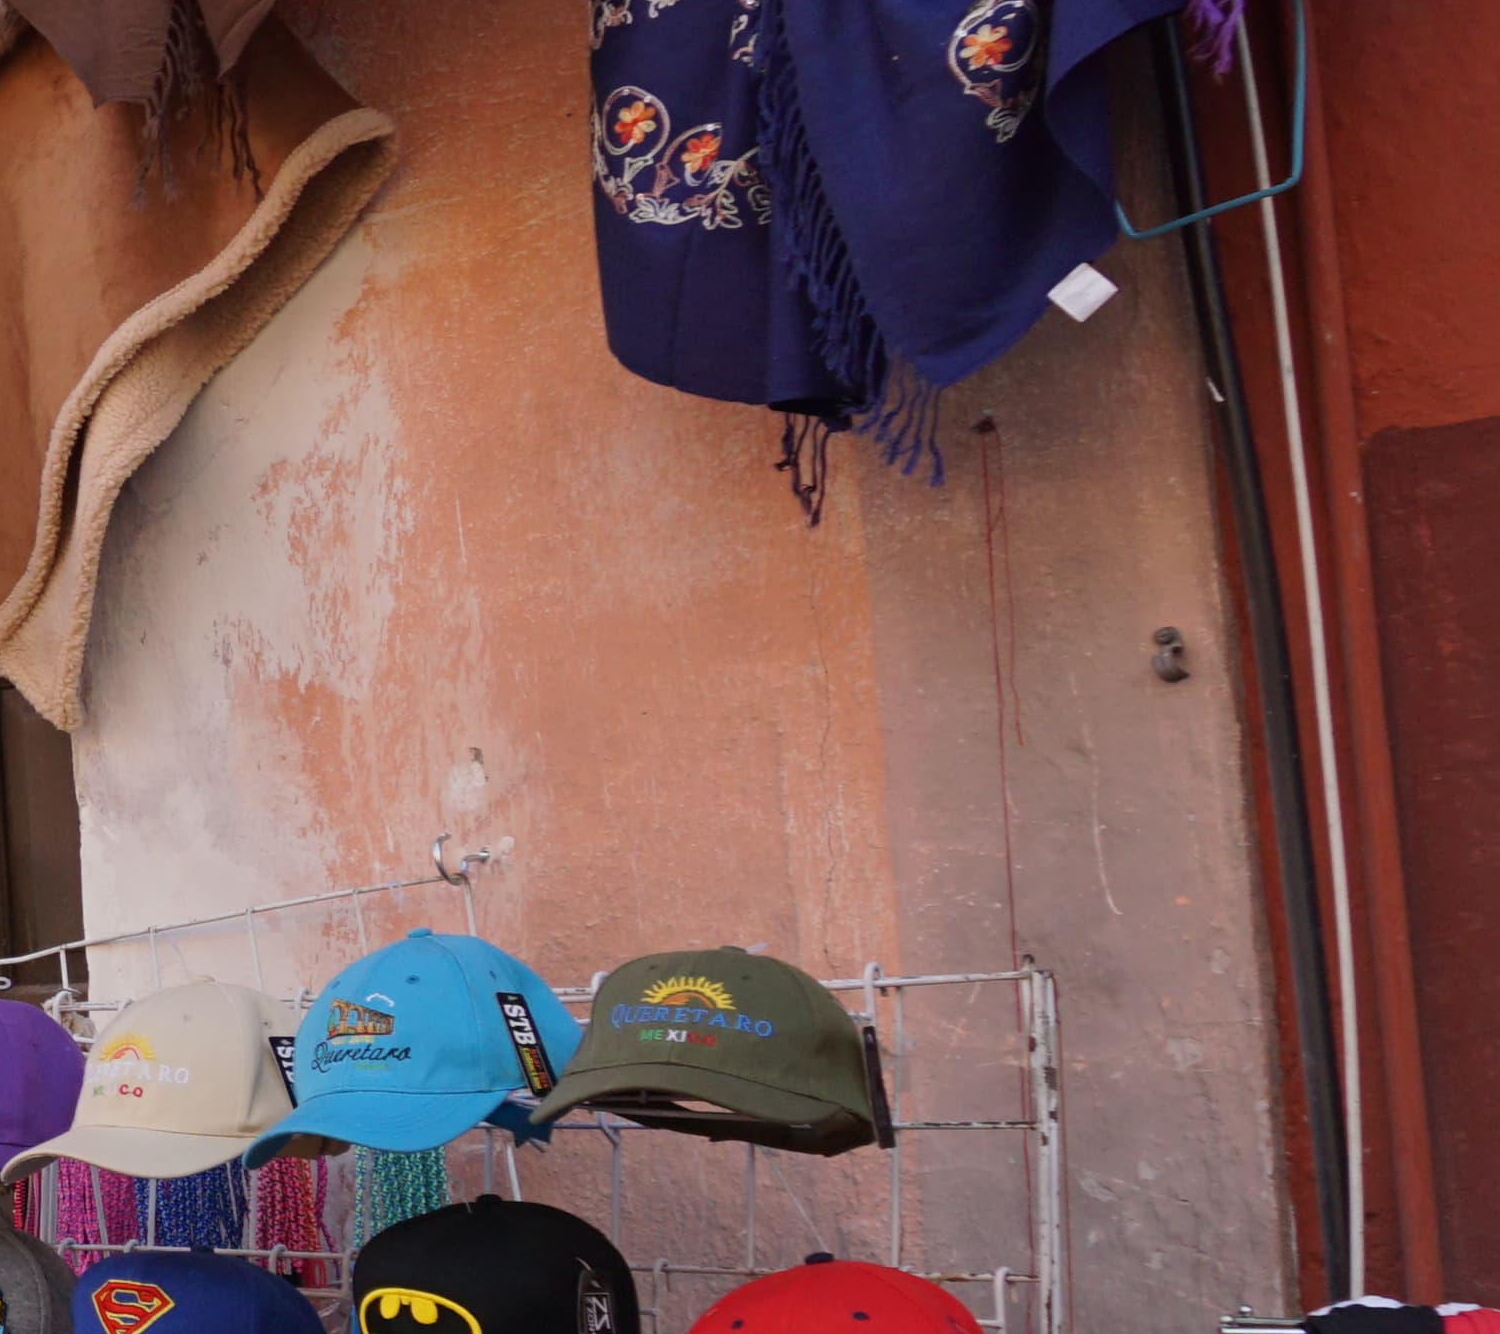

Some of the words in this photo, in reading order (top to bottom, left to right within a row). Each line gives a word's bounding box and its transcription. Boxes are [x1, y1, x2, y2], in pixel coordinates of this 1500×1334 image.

[503, 1003, 537, 1046] STB
[611, 1003, 776, 1039] QUERETARO
[640, 1028, 718, 1048] MEXICO
[311, 1041, 412, 1073] Queretaro
